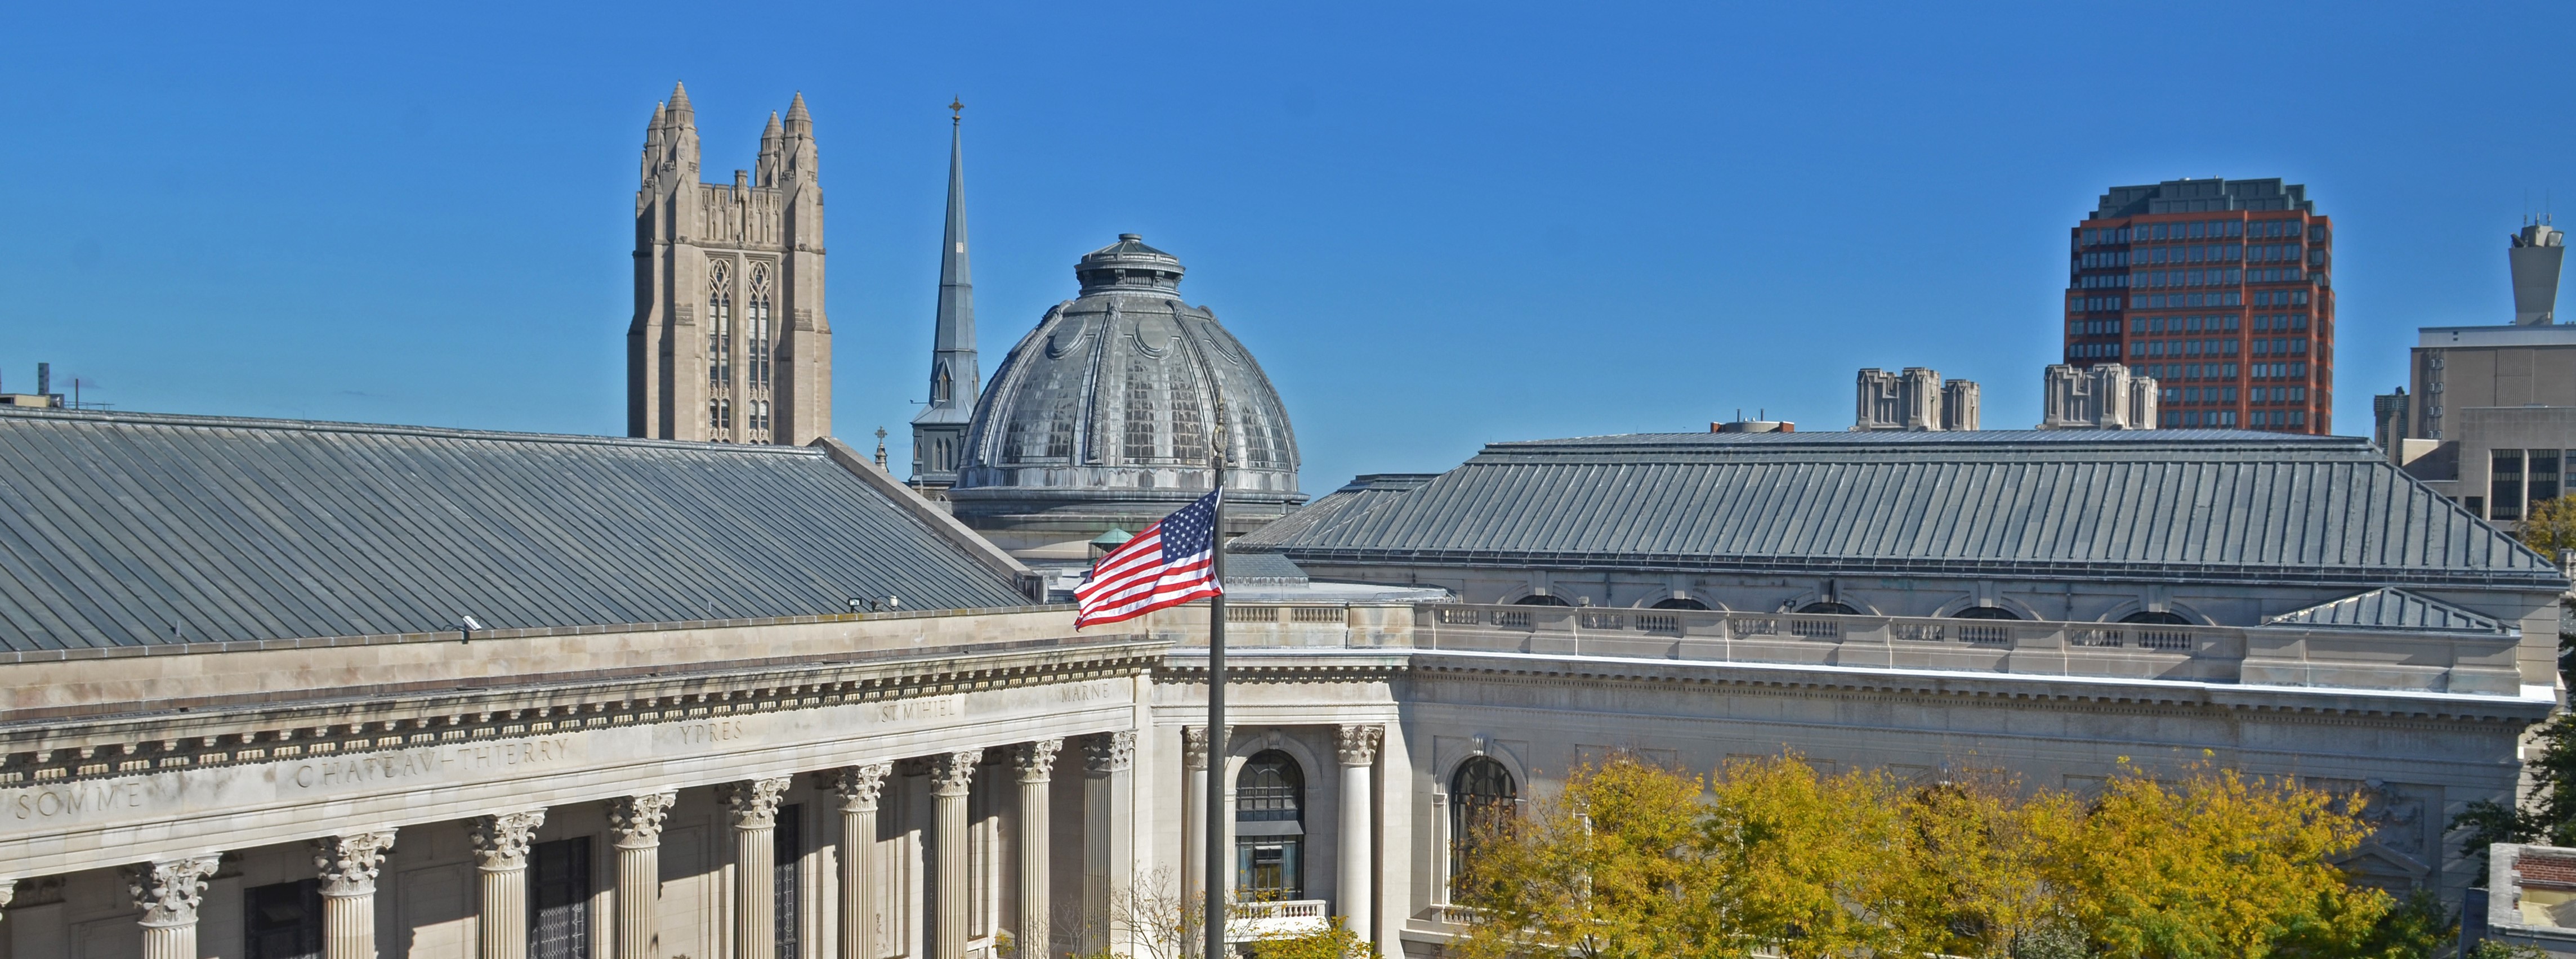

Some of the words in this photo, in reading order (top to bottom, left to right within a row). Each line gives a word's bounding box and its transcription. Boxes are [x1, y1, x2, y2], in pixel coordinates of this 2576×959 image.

[1062, 684, 1110, 702] MARNE
[904, 700, 955, 721] MIHIEL
[680, 721, 742, 745] YPRES
[16, 783, 140, 819] SOMME
